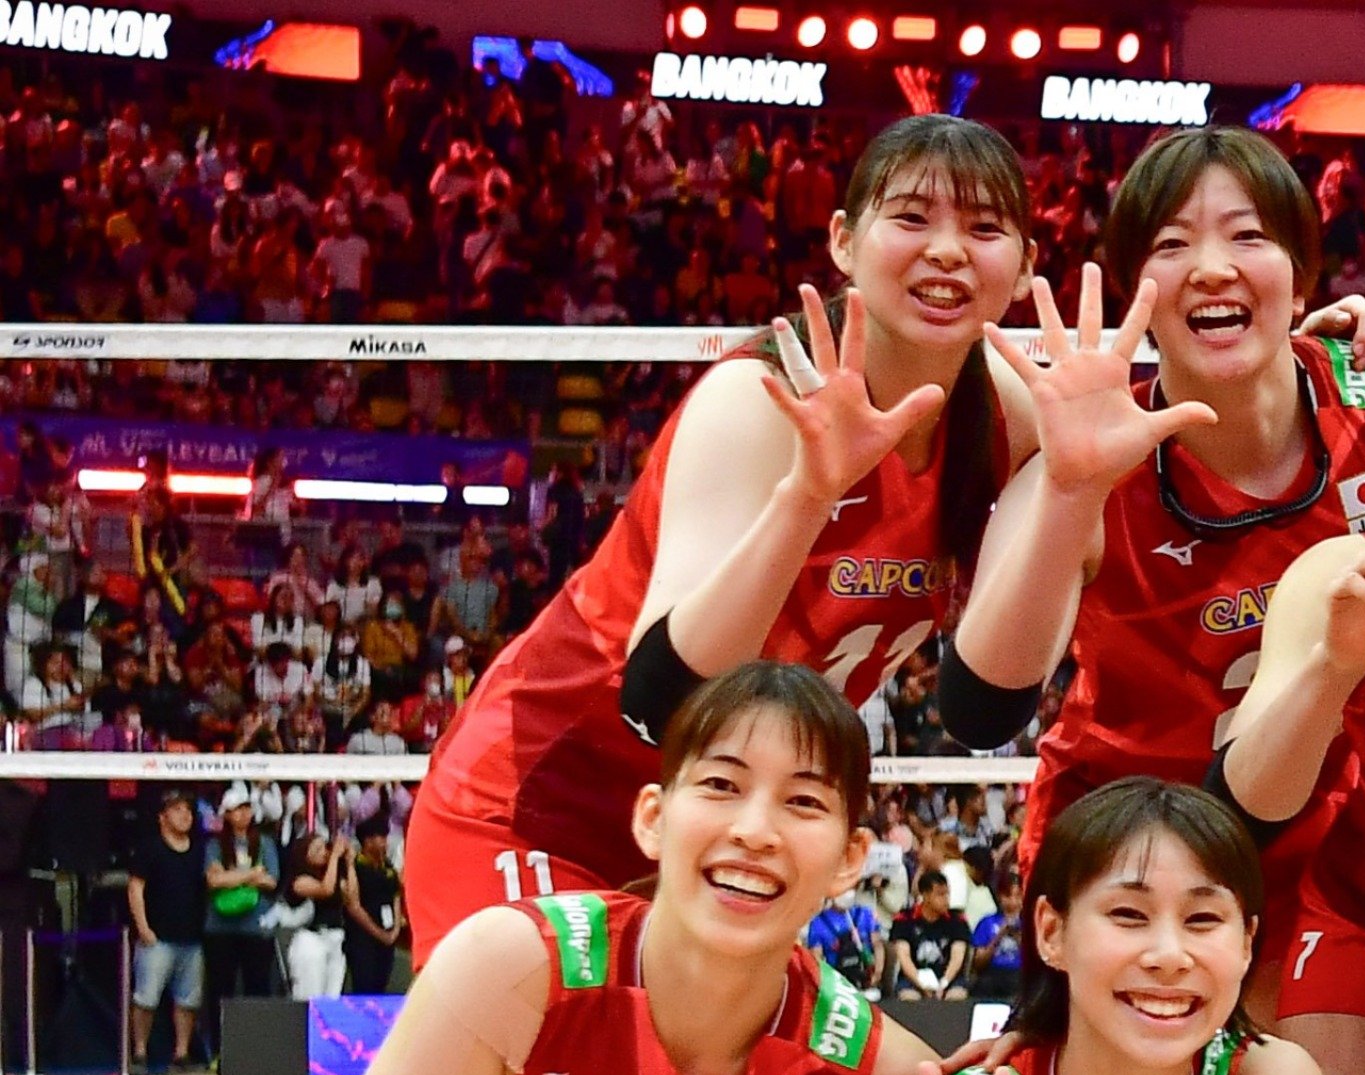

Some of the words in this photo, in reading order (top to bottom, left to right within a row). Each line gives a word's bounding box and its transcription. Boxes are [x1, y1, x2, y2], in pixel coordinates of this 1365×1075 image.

[651, 53, 826, 106] BANGKOK
[1041, 76, 1210, 126] BANGKOK
[349, 336, 427, 354] MIKASA
[495, 850, 554, 902] 11
[1293, 931, 1324, 981] 7
